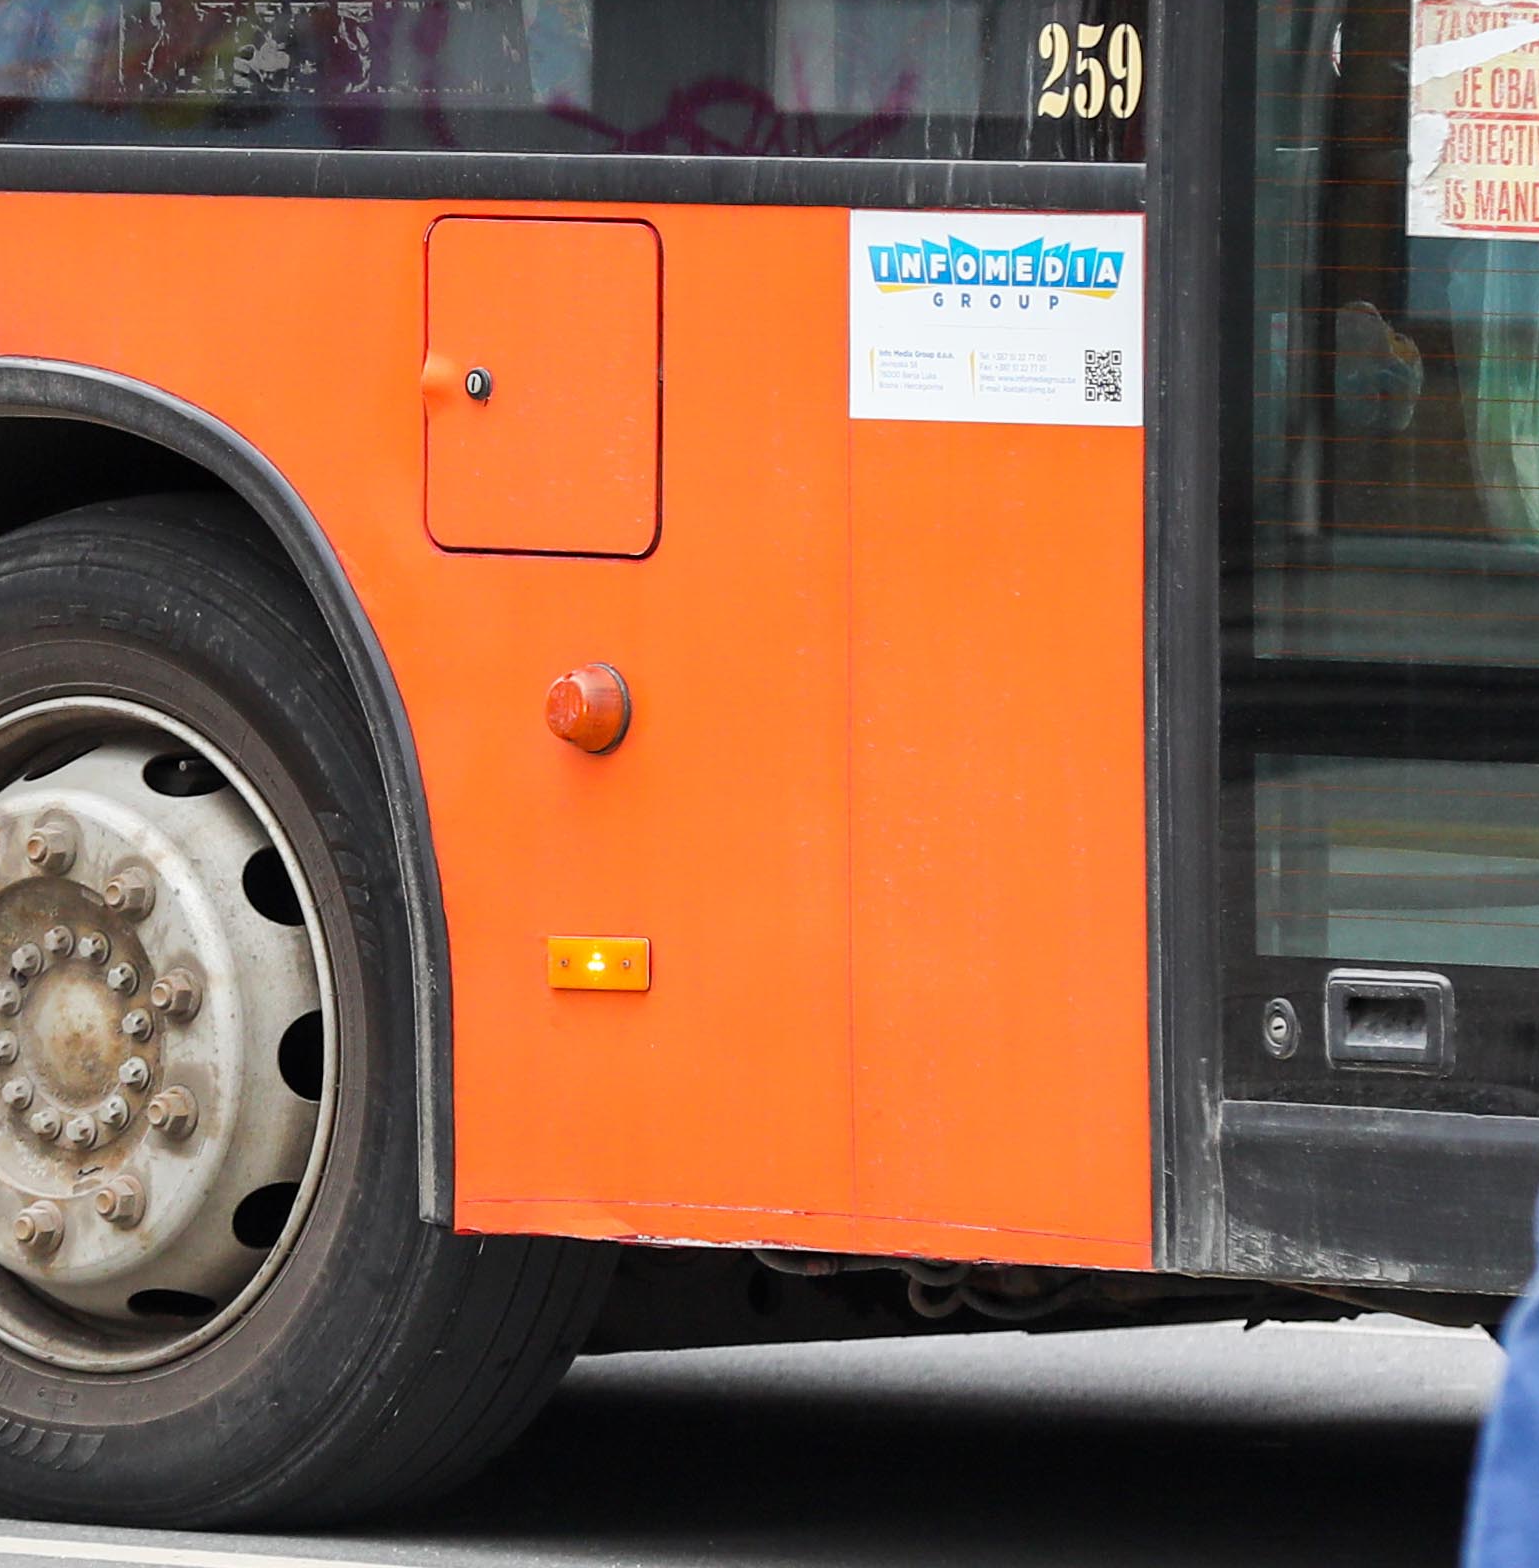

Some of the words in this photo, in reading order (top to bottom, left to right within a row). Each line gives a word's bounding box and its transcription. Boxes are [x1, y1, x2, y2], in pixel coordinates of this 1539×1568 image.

[1037, 22, 1143, 120] 259
[1454, 67, 1483, 108] JE
[1443, 178, 1467, 220] IS
[878, 251, 1119, 284] INFOMEDIA
[932, 292, 1060, 310] GROUP
